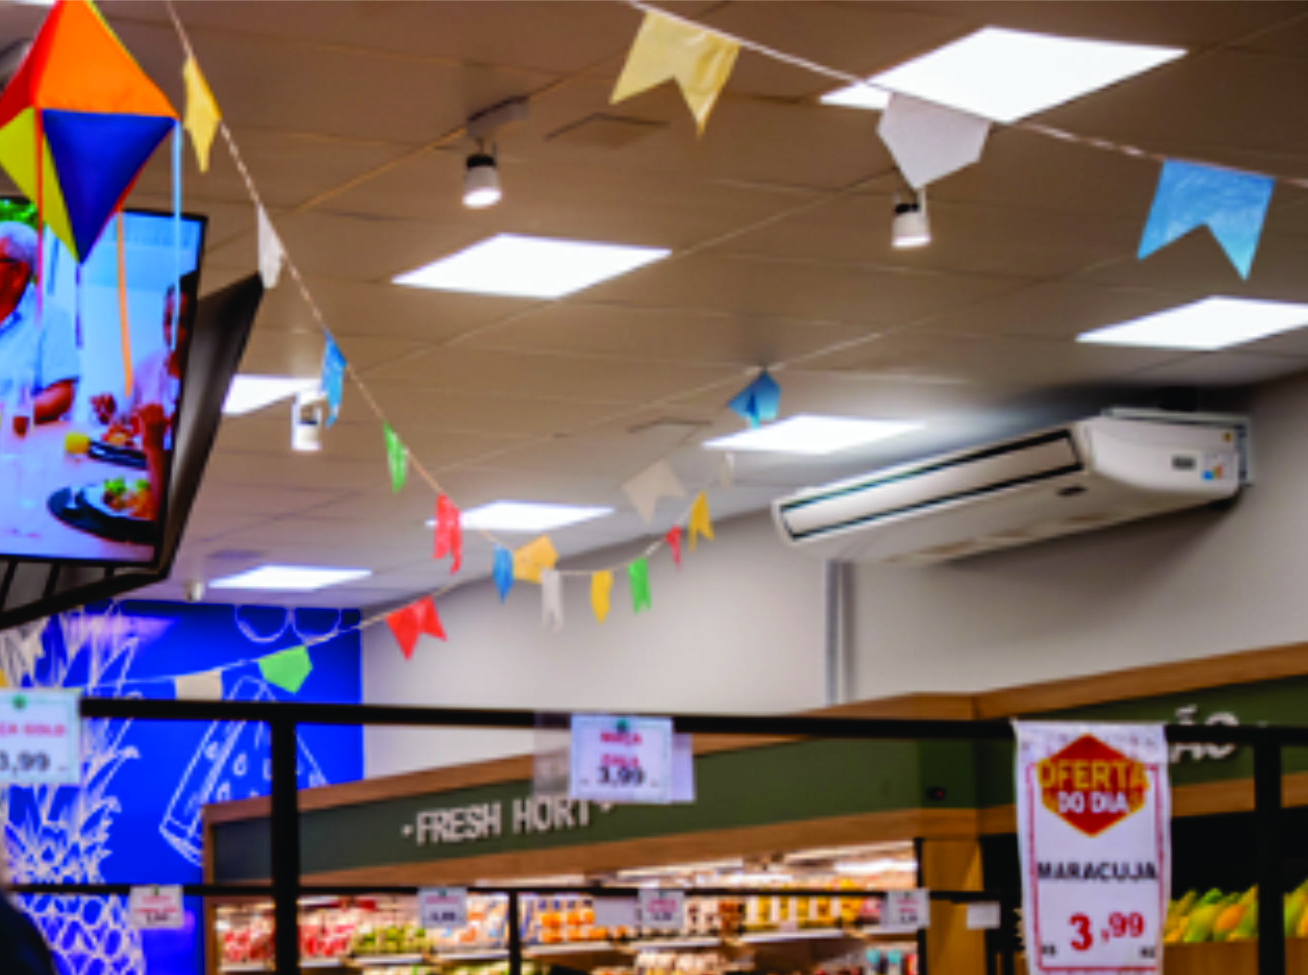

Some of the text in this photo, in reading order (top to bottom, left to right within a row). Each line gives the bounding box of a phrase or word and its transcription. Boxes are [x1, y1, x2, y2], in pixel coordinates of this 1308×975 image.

[596, 766, 646, 787] 3,99
[1036, 758, 1149, 788] OFERTA
[1058, 791, 1128, 813] DO DIA
[416, 796, 590, 845] FRESH HORT
